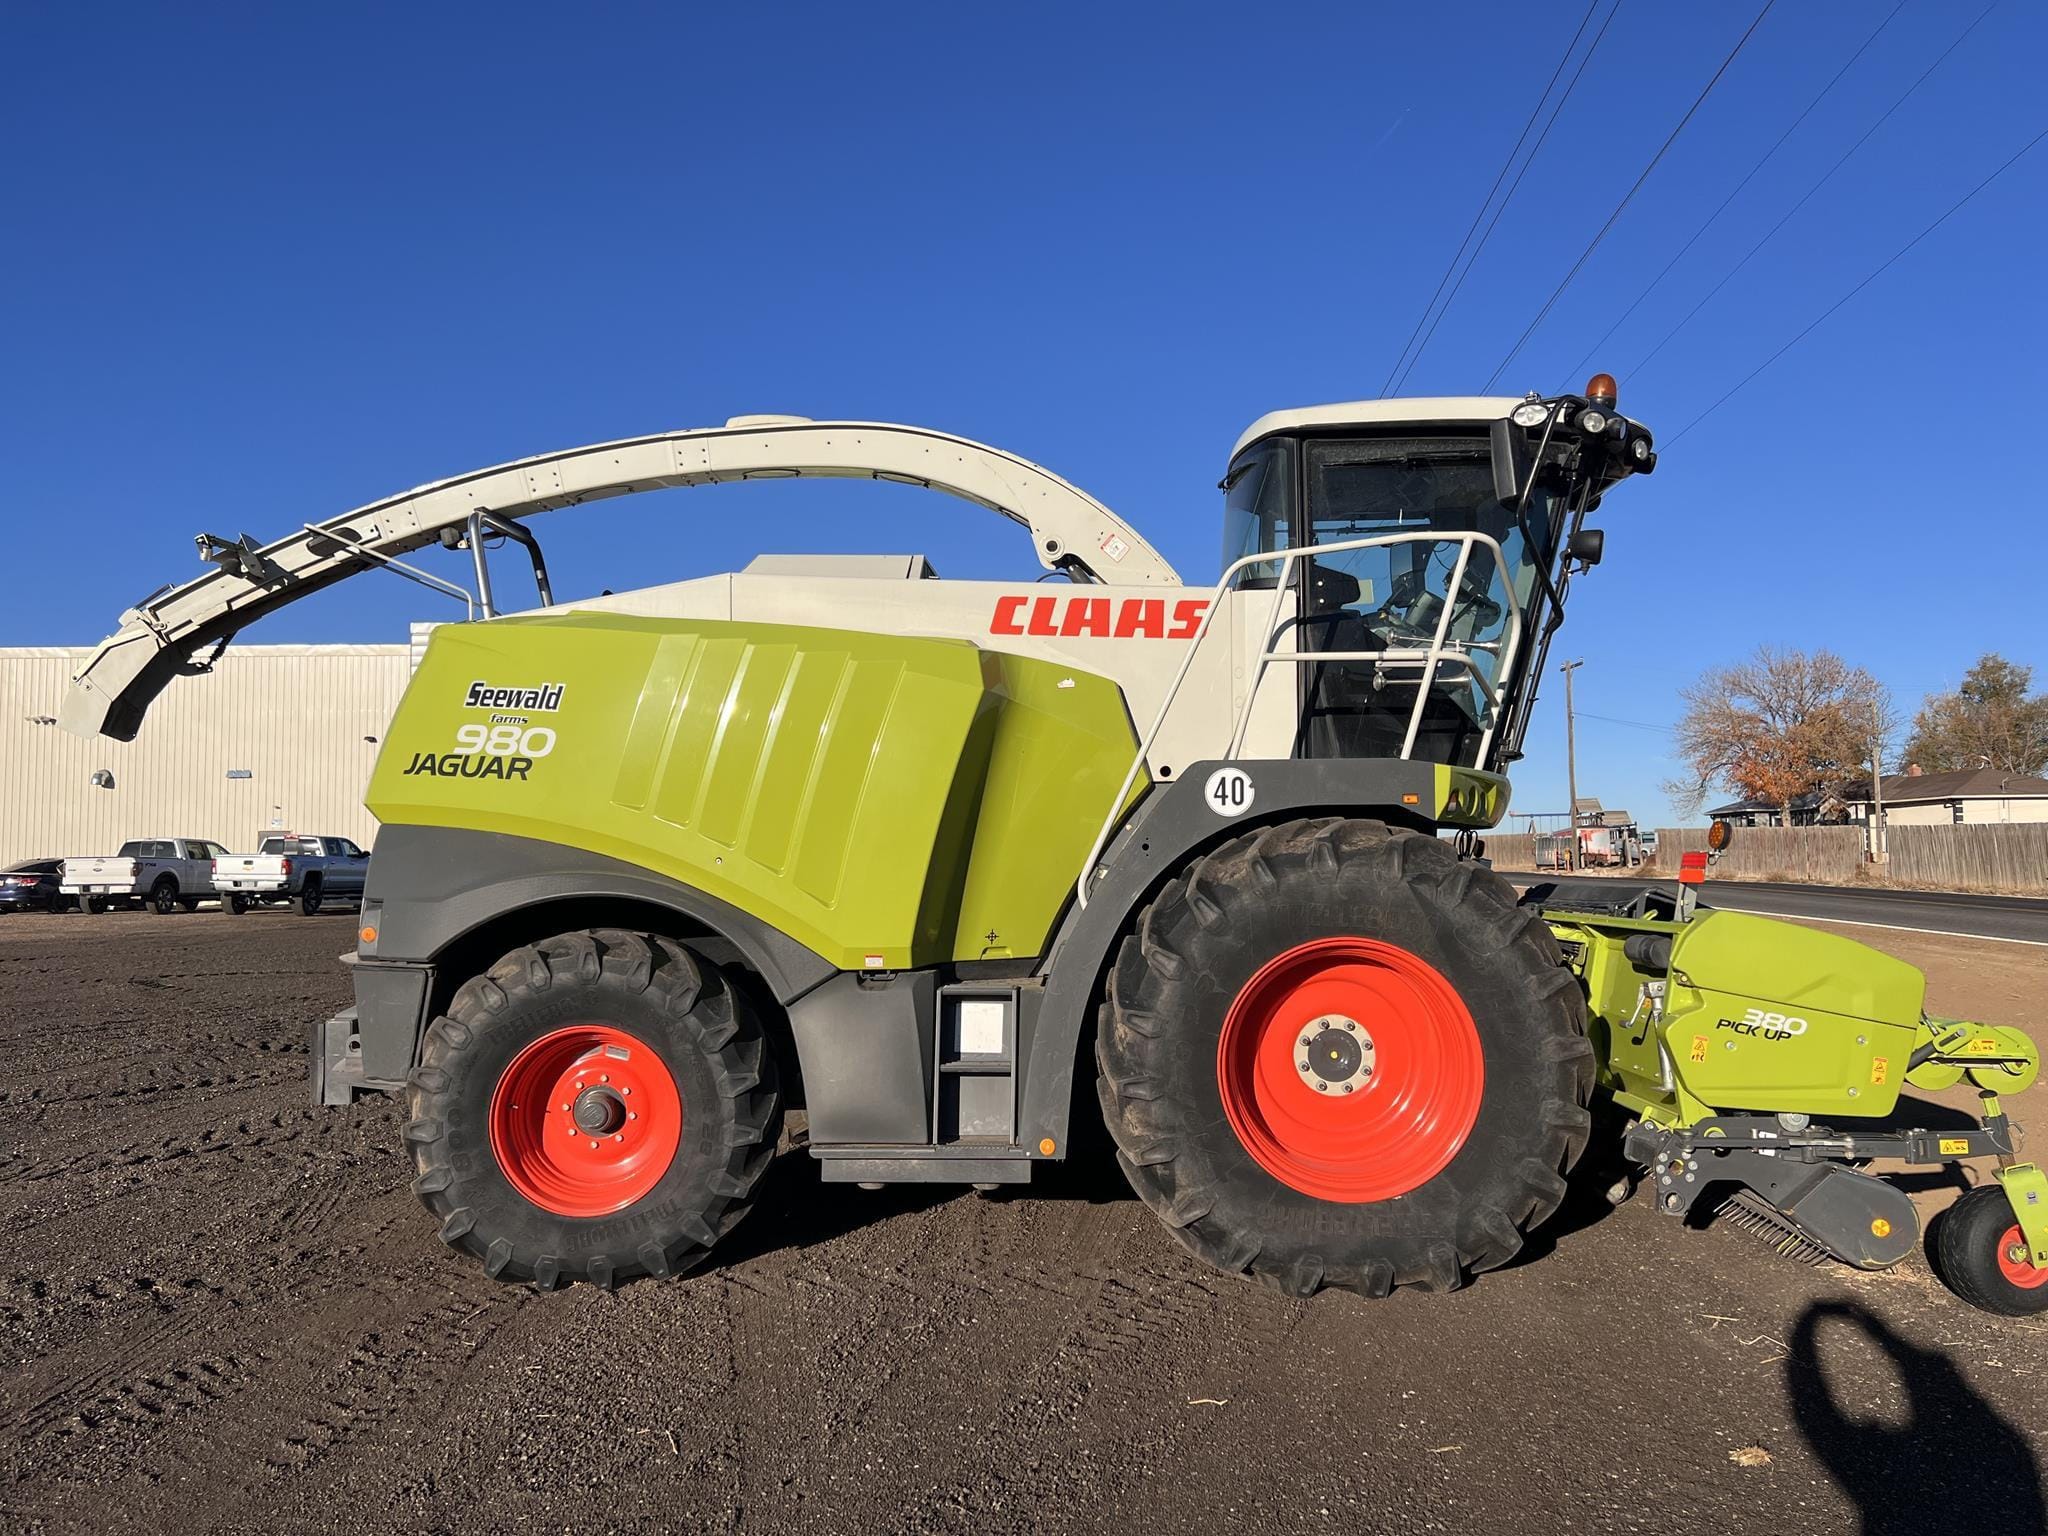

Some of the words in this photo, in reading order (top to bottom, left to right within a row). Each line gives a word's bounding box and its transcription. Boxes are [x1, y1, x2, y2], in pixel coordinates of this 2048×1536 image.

[990, 596, 1210, 640] CLAAS
[464, 681, 564, 711] Seewald
[490, 714, 528, 724] farms
[453, 724, 557, 758] 980
[403, 753, 532, 780] JAGUAR
[1214, 776, 1244, 806] 40
[1716, 1018, 1760, 1037] PICK
[1764, 1027, 1792, 1041] UP
[1741, 1008, 1808, 1035] 380
